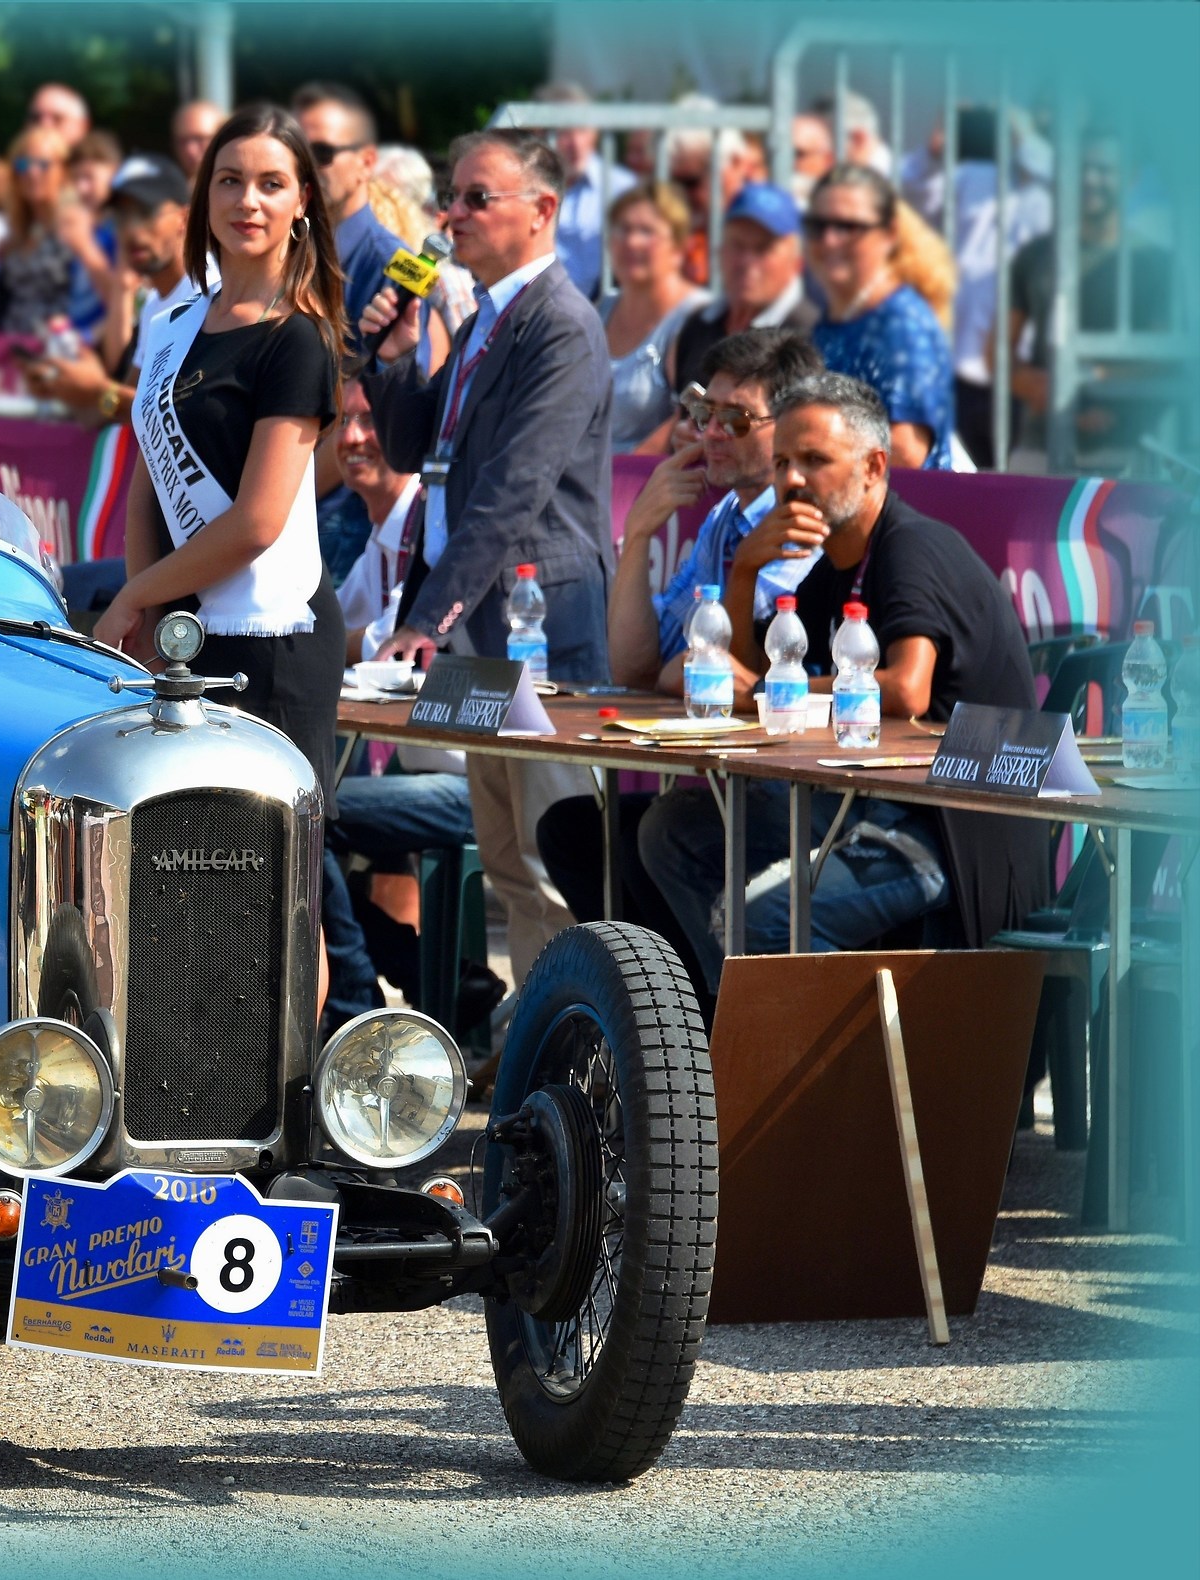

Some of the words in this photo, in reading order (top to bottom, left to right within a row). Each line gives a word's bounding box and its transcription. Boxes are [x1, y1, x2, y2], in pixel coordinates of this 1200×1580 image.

[158, 371, 206, 487] DUCATI
[158, 446, 181, 500] PRIX
[172, 489, 208, 542] MOT
[412, 701, 452, 723] GIURIA
[931, 755, 981, 782] GIURIA
[155, 849, 260, 871] AMILCAR
[23, 1238, 77, 1267] GRAN
[88, 1216, 163, 1251] PREMIO
[218, 1237, 255, 1293] 8
[84, 1332, 99, 1342] Red
[99, 1335, 115, 1344] Bull
[126, 1342, 206, 1359] MASERATI
